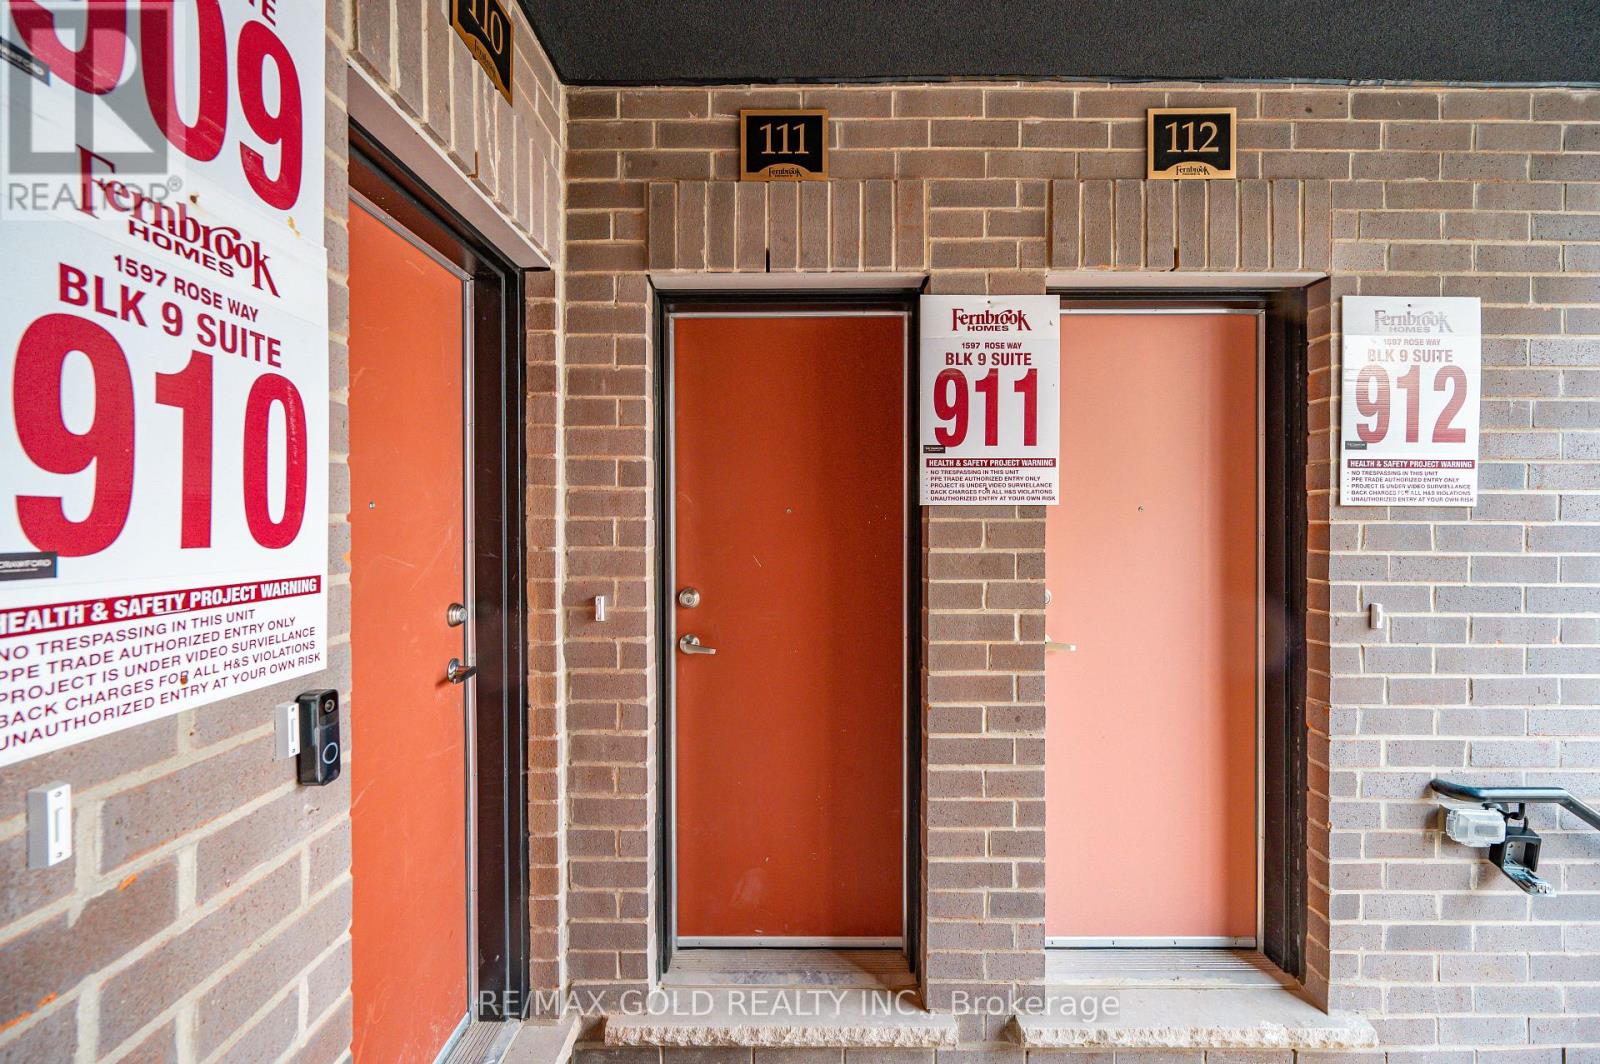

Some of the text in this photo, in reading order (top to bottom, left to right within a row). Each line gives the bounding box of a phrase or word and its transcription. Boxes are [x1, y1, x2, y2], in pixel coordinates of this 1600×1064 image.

[760, 123, 809, 154] 111
[1165, 121, 1219, 153] 112
[76, 143, 281, 298] Fernbrook
[128, 219, 235, 278] HOMES
[58, 262, 282, 369] BLK 9 SUITE
[114, 254, 258, 323] 1597 ROSE WAY
[952, 308, 1032, 332] Fernbrook
[945, 352, 1032, 366] BLK 9 SUITE
[1367, 349, 1453, 362] BLK 9 SUITE
[933, 367, 1038, 447] 911
[1355, 364, 1468, 444] 912
[13, 312, 308, 558] 910
[929, 459, 1053, 467] HEALTH & SAFETY PROJECT WARNING
[1350, 460, 1374, 468] HEALTH
[1384, 460, 1408, 468] SAFETY
[1409, 460, 1439, 468] PROJECT
[1441, 460, 1472, 468] WARNING
[90, 602, 109, 622] &
[114, 593, 188, 619] SAFETY
[190, 585, 258, 608] PROJECT
[260, 579, 317, 598] WARNING
[36, 623, 167, 655] TRESPASSING
[172, 620, 187, 632] IN
[191, 614, 222, 629] THIS
[226, 609, 256, 623] UNIT
[46, 650, 114, 674] TRADE
[119, 630, 220, 660] AUTHORIZED
[224, 622, 265, 639] ENTRY
[267, 616, 296, 631] ONLY
[103, 668, 118, 683] IS
[125, 655, 181, 678] UNDER
[186, 645, 228, 663] VIDEO
[232, 626, 316, 653] SURVIELLANCE
[65, 678, 154, 711] CHARGES
[193, 663, 219, 678] ALL
[224, 656, 249, 671] H&S
[252, 640, 316, 664] VIOLATIONS
[160, 682, 208, 704] ENTRY
[212, 676, 230, 690] AT
[232, 667, 266, 683] YOUR
[269, 659, 295, 674] OWN
[297, 652, 320, 667] RISK
